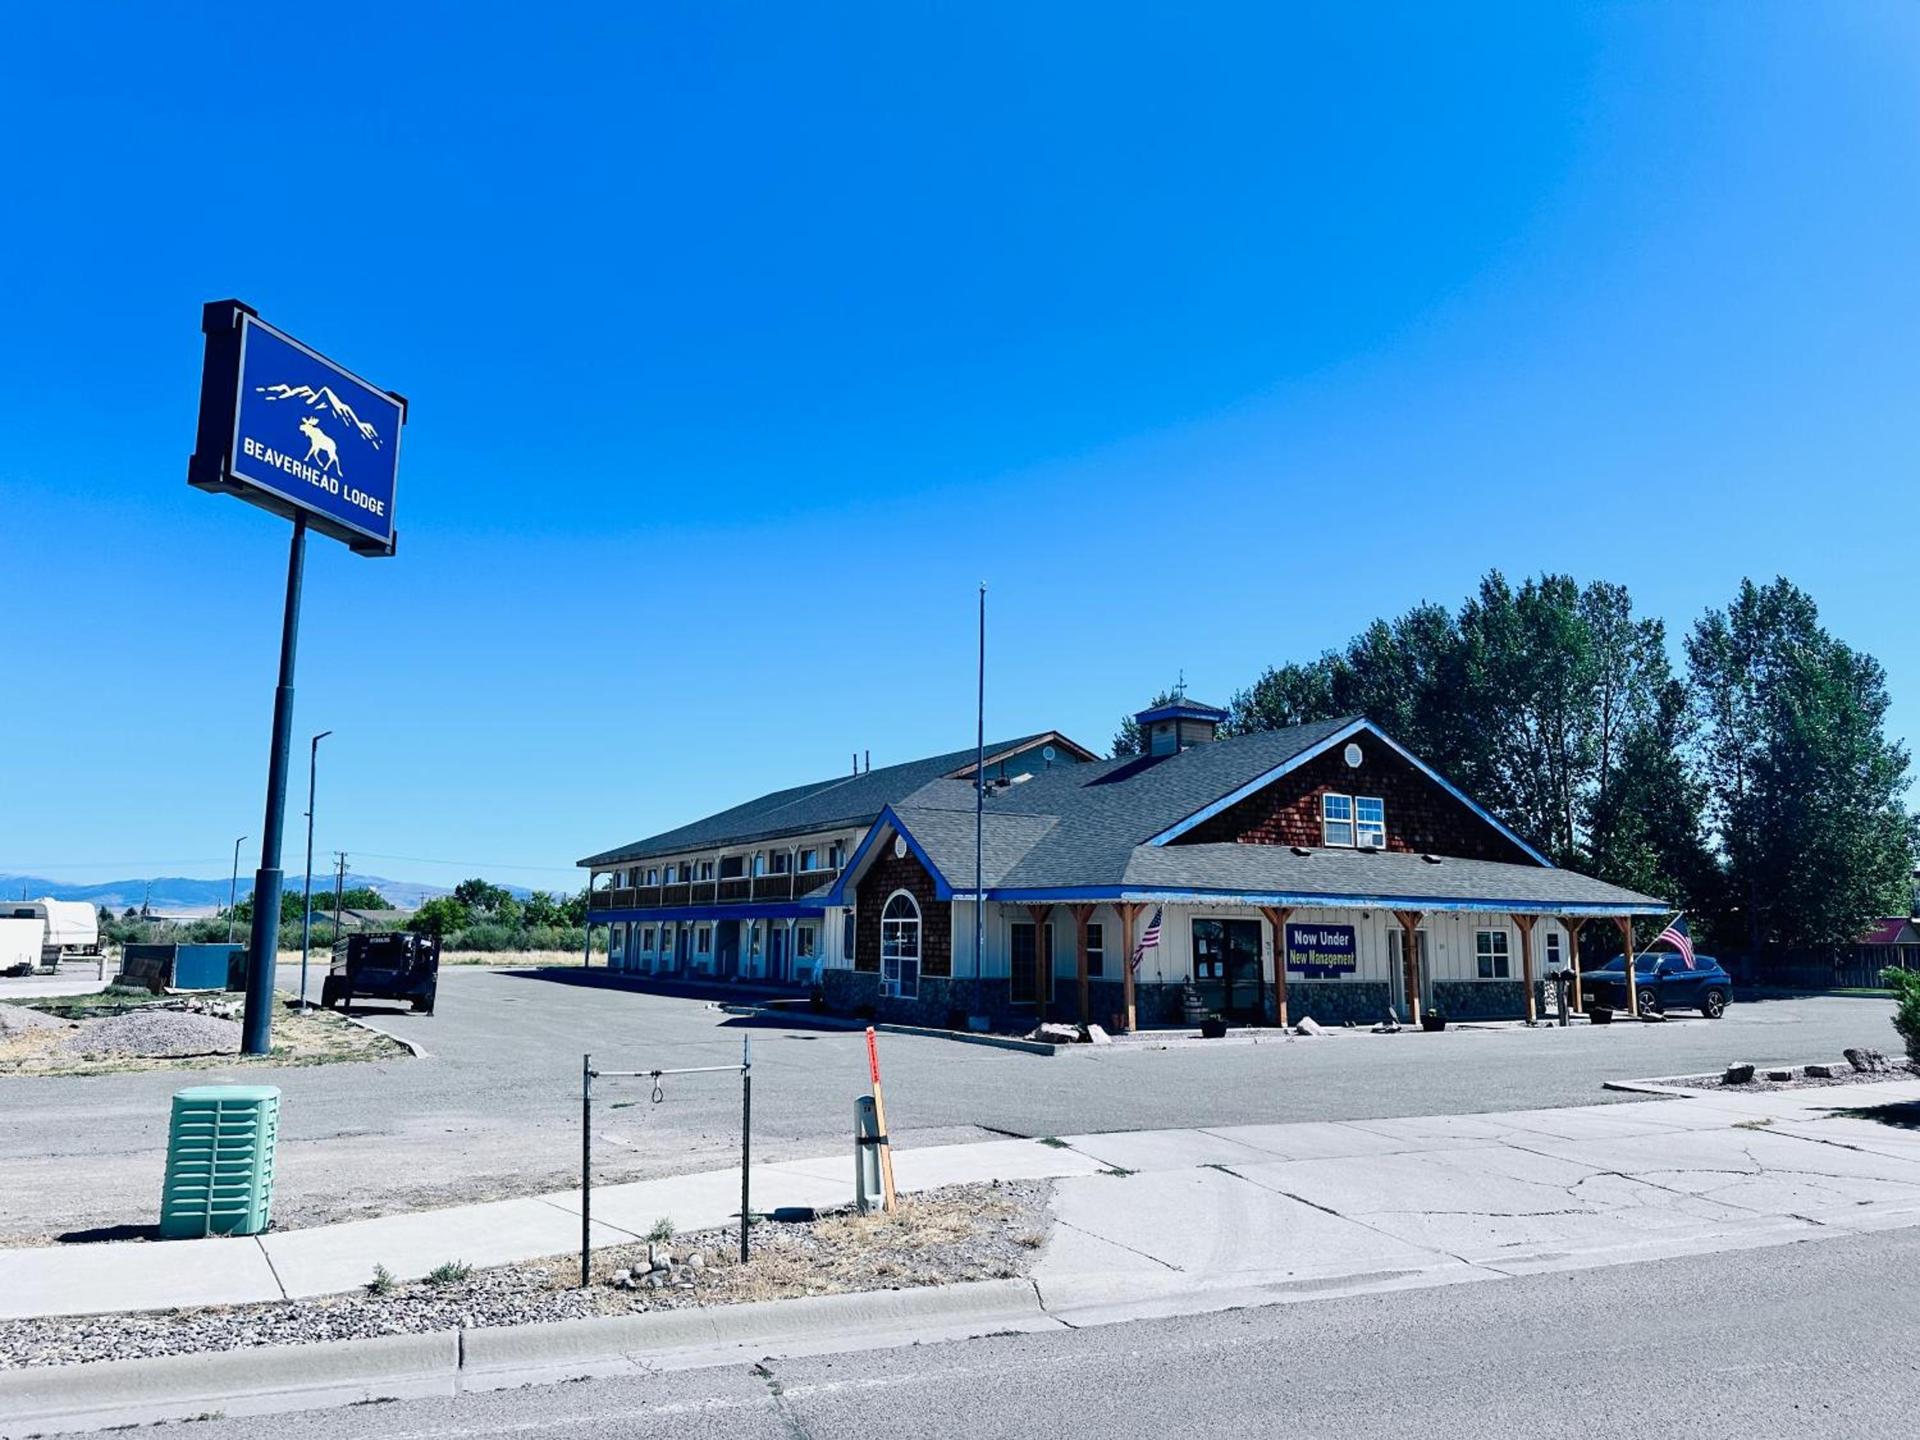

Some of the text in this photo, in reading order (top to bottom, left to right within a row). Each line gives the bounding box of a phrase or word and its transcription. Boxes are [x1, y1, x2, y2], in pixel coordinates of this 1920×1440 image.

[244, 437, 385, 516] BEAVERHEAD LODGE
[1294, 930, 1349, 945] Now Under
[1290, 949, 1354, 968] New Management
